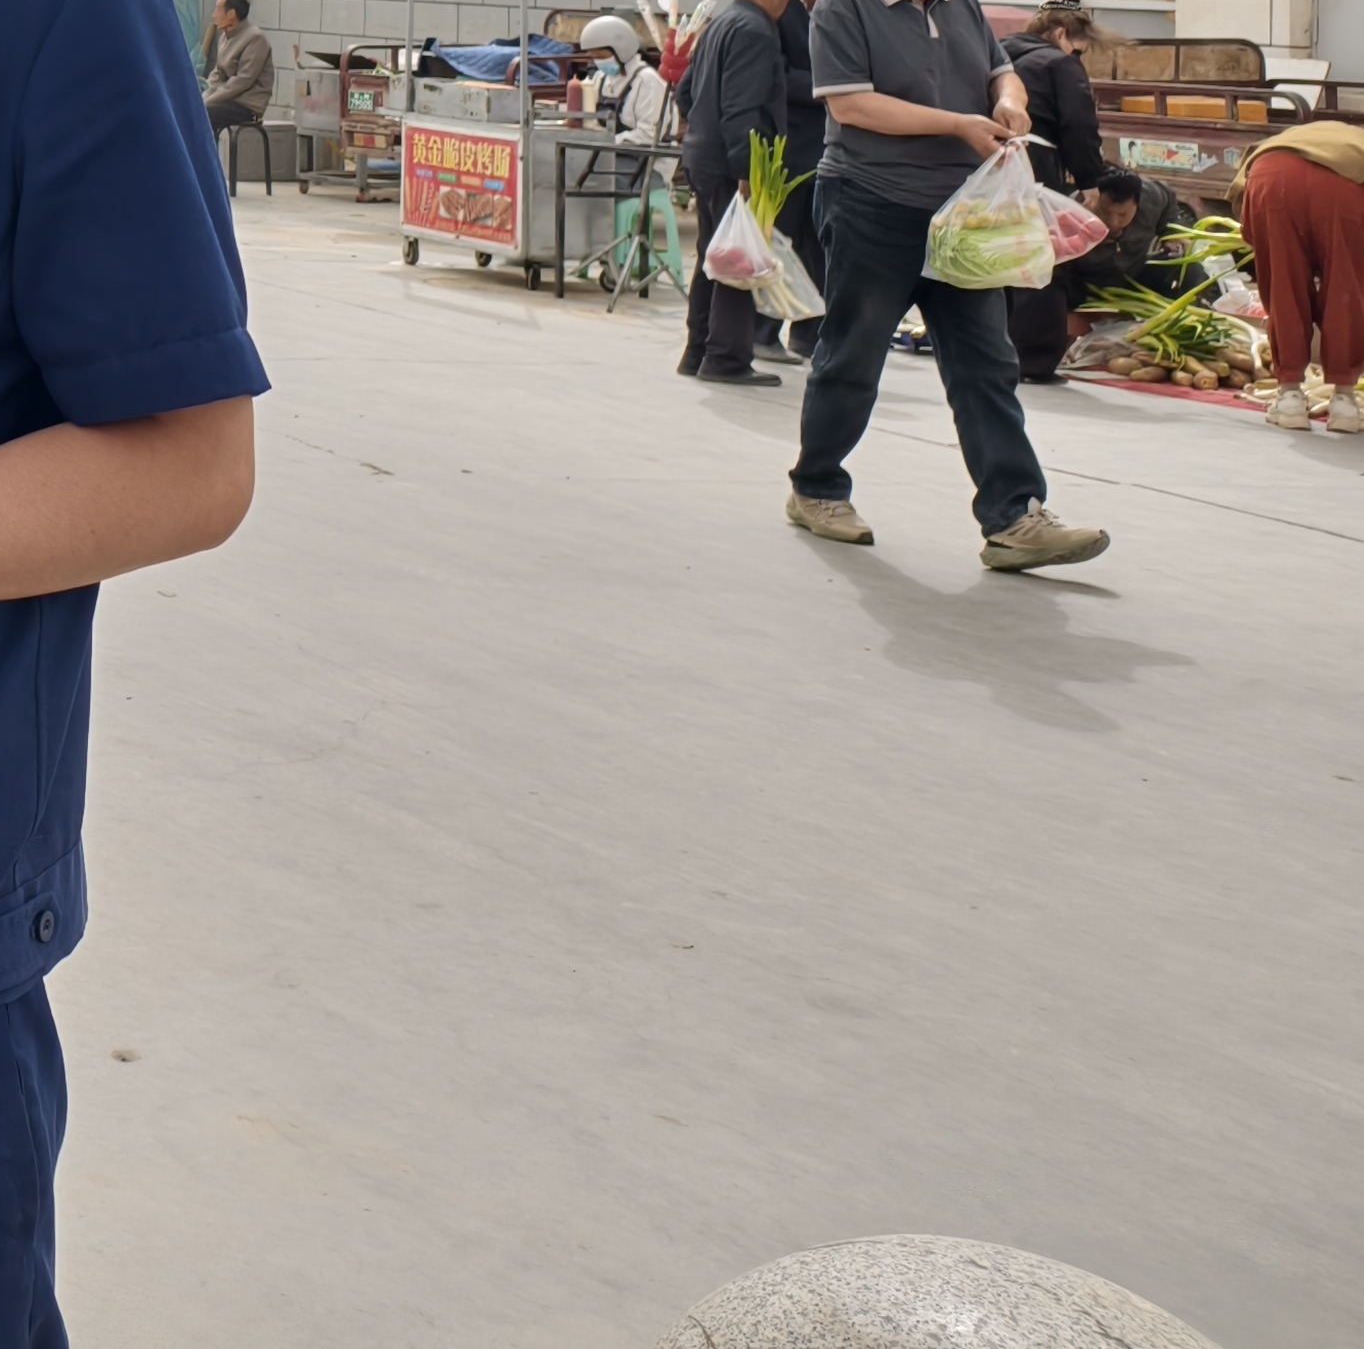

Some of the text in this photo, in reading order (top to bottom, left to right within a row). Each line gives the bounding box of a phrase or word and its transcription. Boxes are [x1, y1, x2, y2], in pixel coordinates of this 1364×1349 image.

[412, 133, 511, 179] 黄金脆皮烤肠
